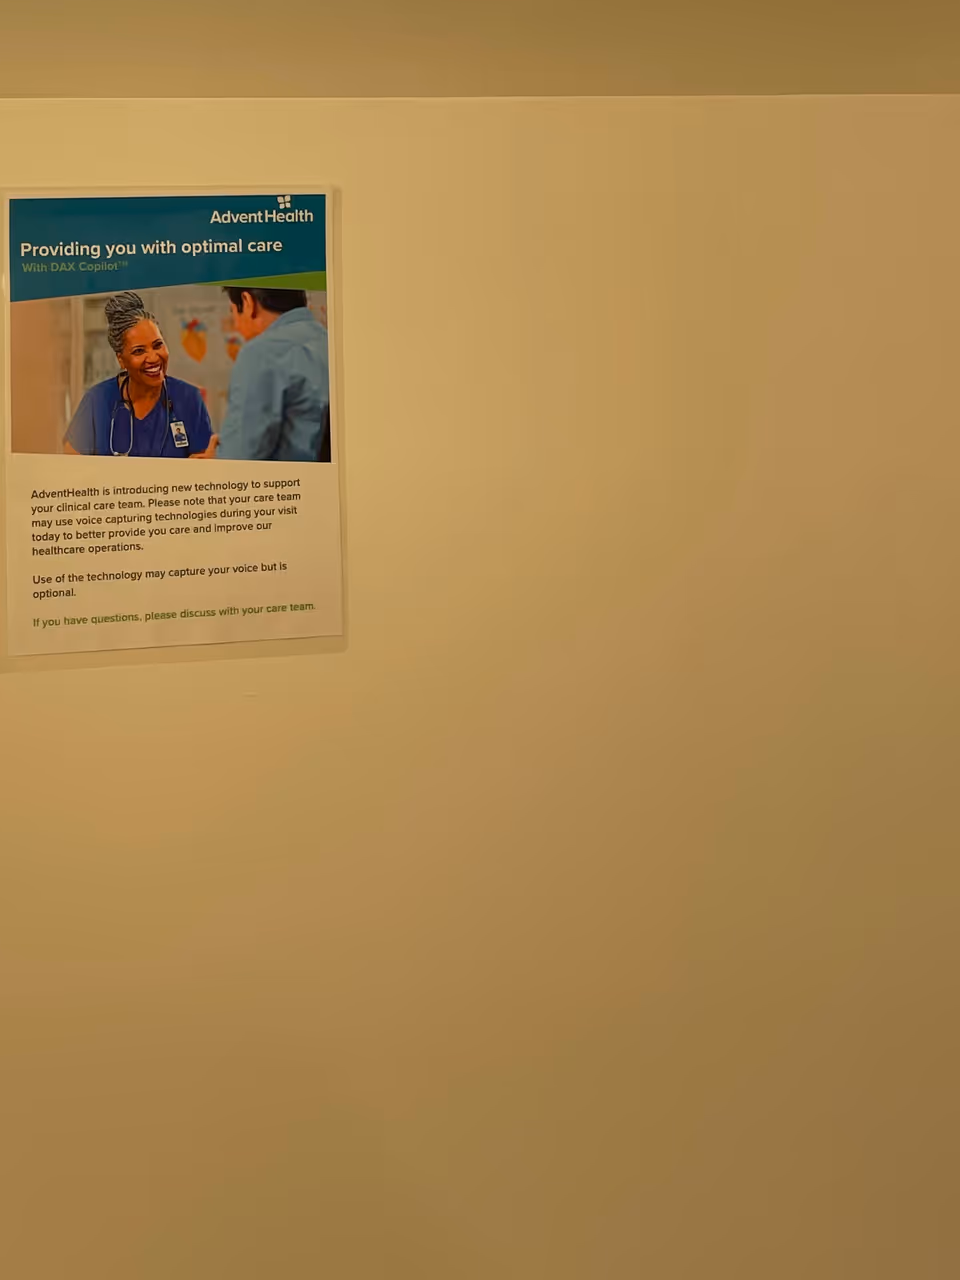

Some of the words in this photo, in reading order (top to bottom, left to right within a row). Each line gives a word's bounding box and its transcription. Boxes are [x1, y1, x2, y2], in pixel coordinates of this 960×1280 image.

[210, 209, 314, 224] AdventHealth
[20, 239, 101, 259] Providing
[105, 243, 137, 259] you
[141, 239, 176, 256] with
[181, 238, 243, 257] optimal
[247, 240, 283, 253] care
[22, 261, 48, 273] With
[50, 261, 76, 272] DAX
[31, 487, 100, 499] AdventHealth
[102, 486, 111, 496] is
[113, 484, 169, 495] introducing
[171, 484, 193, 492] new
[194, 481, 249, 492] technology
[251, 480, 261, 489] to
[263, 478, 301, 489] support
[31, 504, 54, 515] your
[56, 502, 91, 512] clinical
[93, 502, 116, 511] care
[118, 500, 146, 510] team.
[148, 498, 181, 508] Please
[183, 497, 205, 506] note
[207, 495, 227, 505] that
[229, 495, 251, 505] your
[253, 494, 275, 502] care
[276, 492, 301, 501] team
[31, 519, 53, 529] may
[55, 518, 74, 526] use
[75, 515, 103, 525] voice
[105, 513, 152, 525] capturing
[154, 509, 218, 521] technologies
[220, 508, 252, 519] during
[253, 507, 276, 518] your
[277, 505, 298, 515] visit
[31, 531, 60, 542] today
[62, 531, 73, 540] to
[75, 529, 106, 540] better
[108, 527, 146, 540] provide
[148, 528, 167, 539] you
[169, 526, 191, 535] care
[193, 524, 212, 534] and
[214, 522, 254, 534] improve
[256, 521, 273, 531] our
[31, 545, 85, 556] healthcare
[88, 542, 144, 555] operations.
[32, 575, 53, 585] Use
[55, 574, 66, 583] of
[68, 572, 85, 582] the
[87, 570, 143, 582] technology
[145, 569, 166, 580] may
[168, 567, 206, 578] capture
[208, 566, 230, 577] your
[232, 564, 259, 573] voice
[261, 562, 277, 572] but
[279, 561, 288, 571] is
[32, 588, 77, 600] optional.
[33, 618, 40, 627] If
[41, 618, 61, 629] you
[63, 616, 88, 626] have
[144, 611, 177, 622] please
[180, 608, 217, 618] discuss
[218, 606, 240, 616] with
[241, 605, 264, 616] your
[266, 603, 287, 613] care
[289, 602, 316, 612] team.
